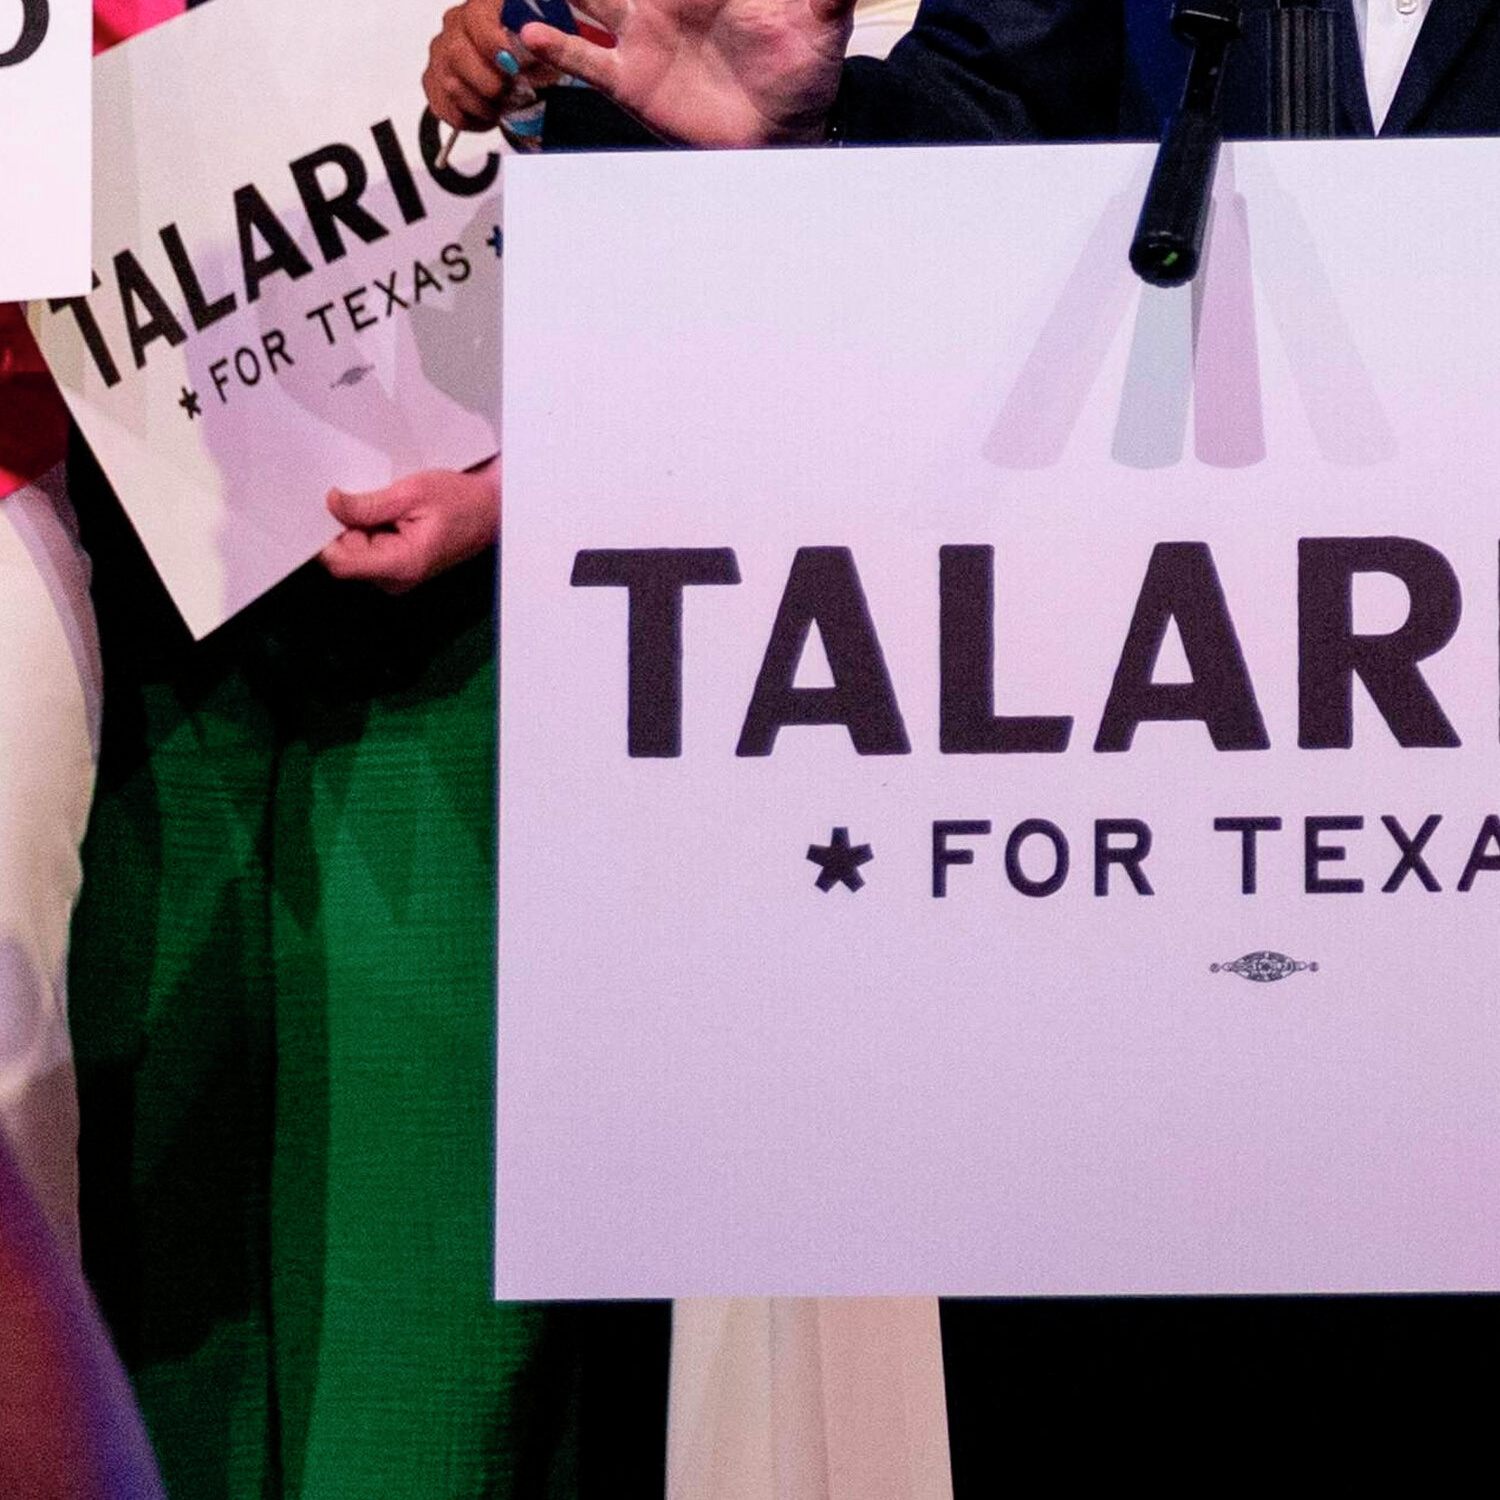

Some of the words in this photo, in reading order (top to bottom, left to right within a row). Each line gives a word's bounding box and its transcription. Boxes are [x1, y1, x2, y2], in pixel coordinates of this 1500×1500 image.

[207, 329, 295, 404] FOR
[306, 242, 473, 346] TEXAS
[932, 819, 1154, 898] FOR
